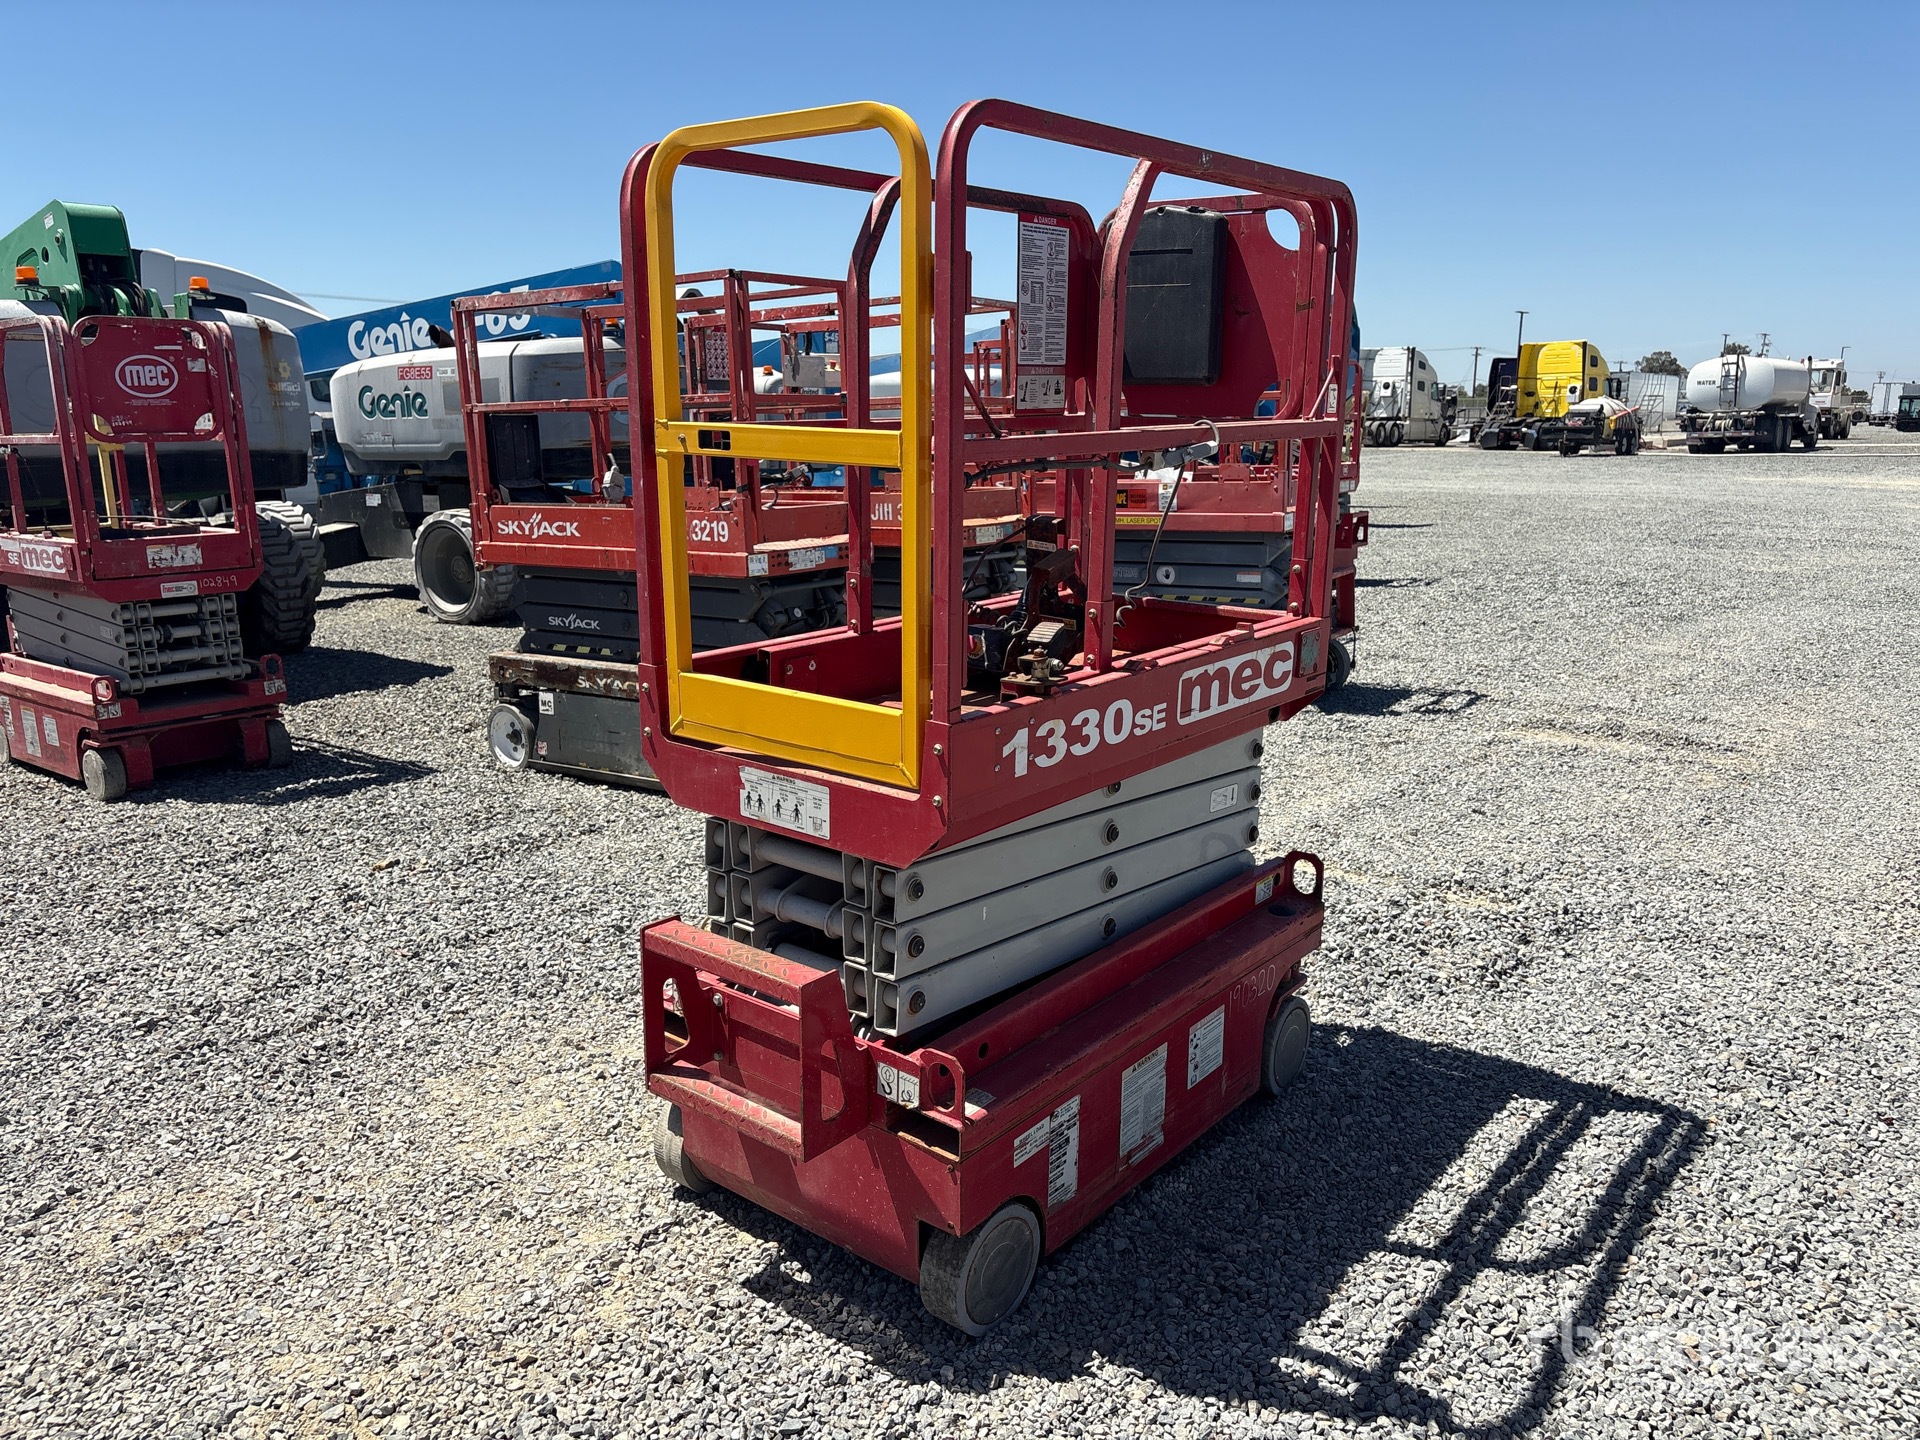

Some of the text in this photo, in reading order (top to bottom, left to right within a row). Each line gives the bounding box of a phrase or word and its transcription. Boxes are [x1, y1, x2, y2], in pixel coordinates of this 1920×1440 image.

[1039, 216, 1058, 225] DANGER
[348, 312, 431, 360] Genie
[125, 365, 170, 387] mec
[398, 368, 432, 380] FG8E55
[1036, 367, 1054, 375] DANGER
[358, 385, 429, 421] Genie
[497, 512, 581, 539] SKYJACK
[692, 519, 729, 543] 3219
[8, 546, 66, 572] SE mec
[200, 575, 238, 588] 102849
[548, 613, 601, 630] SKYJACK
[1179, 649, 1293, 719] mec
[776, 775, 796, 785] WARNING
